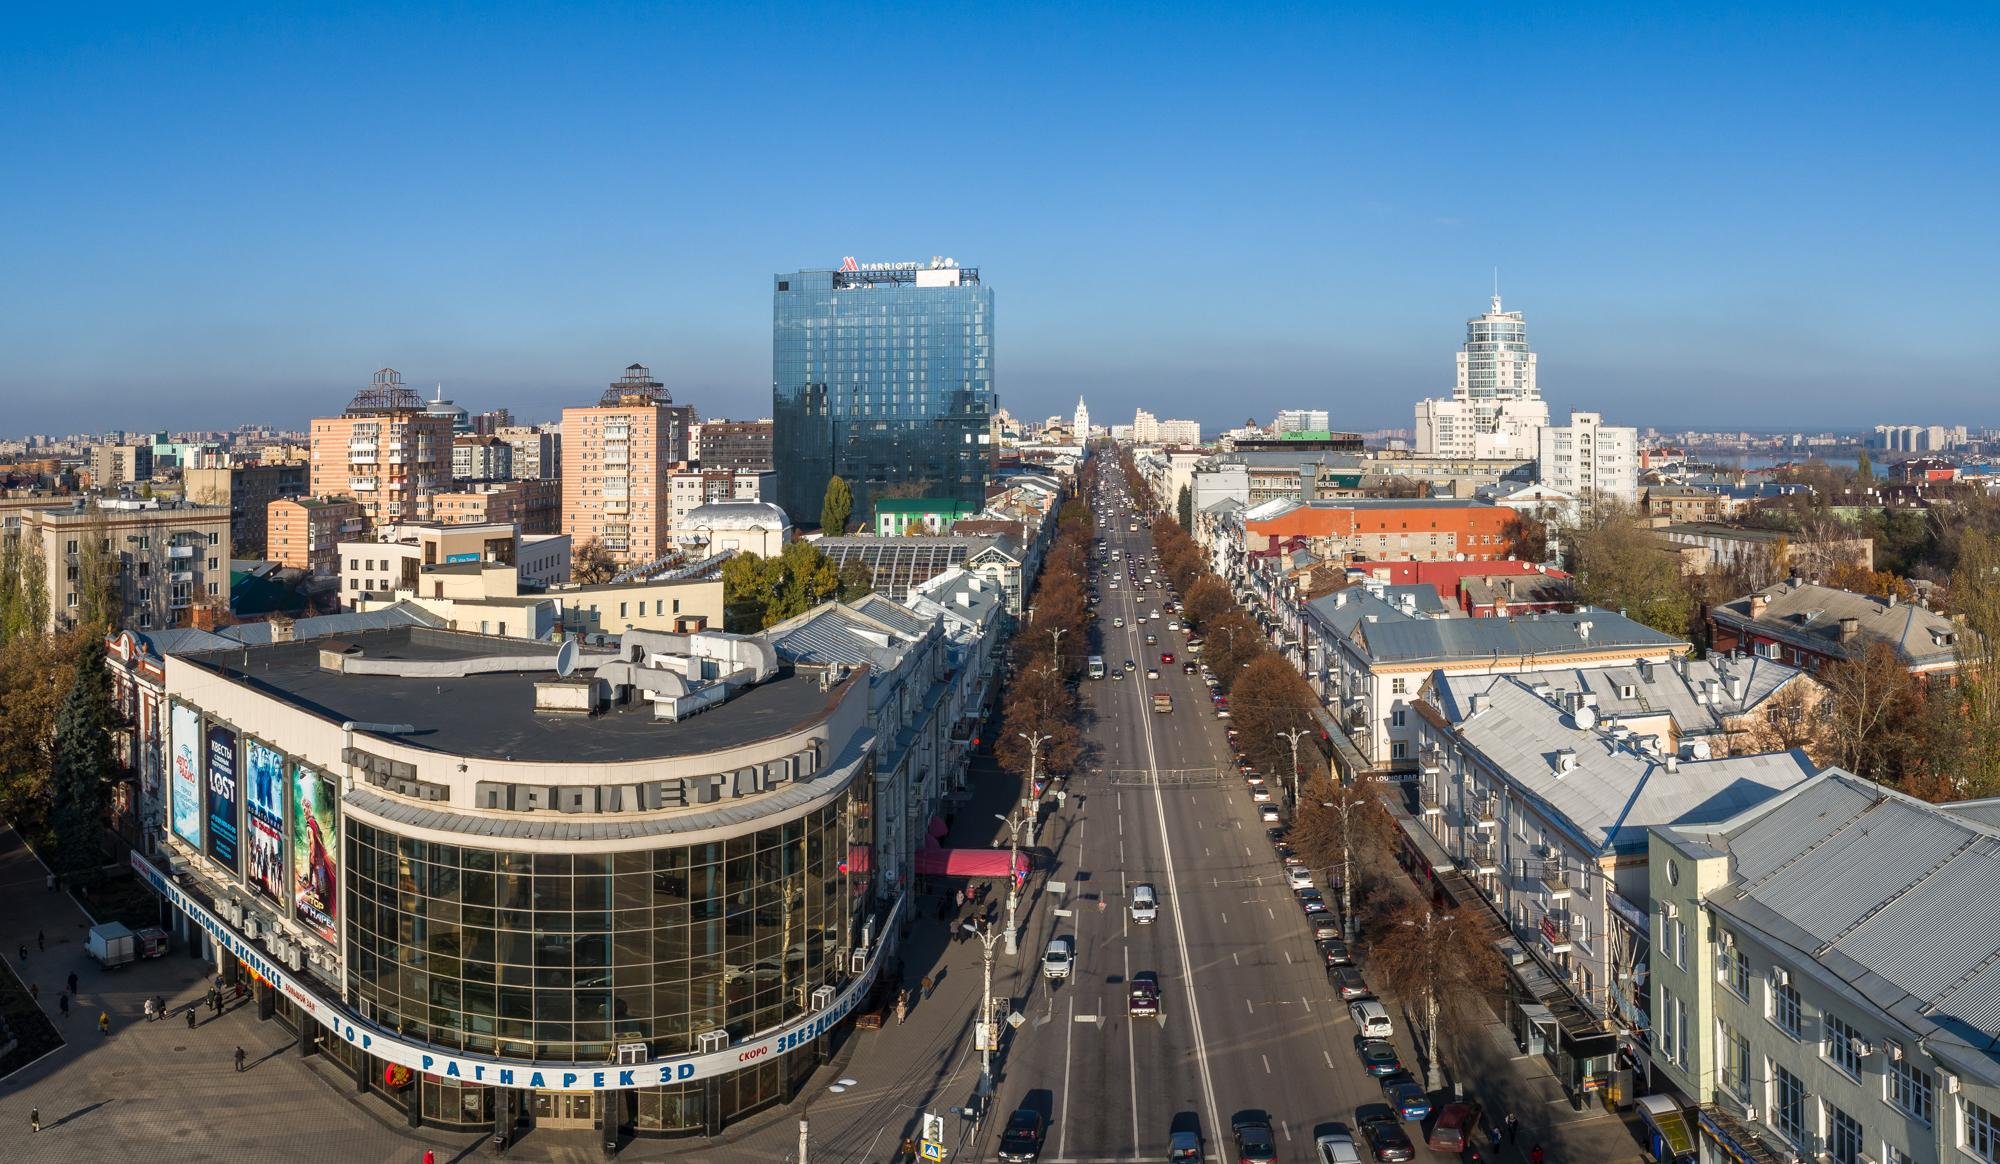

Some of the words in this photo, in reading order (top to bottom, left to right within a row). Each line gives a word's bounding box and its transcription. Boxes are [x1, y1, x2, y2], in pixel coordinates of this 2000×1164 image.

[861, 262, 916, 271] MARRIOTT
[211, 740, 232, 760] КВЕСТЫ
[209, 768, 235, 803] LOST
[308, 896, 325, 910] ТОР
[189, 904, 232, 949] ВОСТОЧНОМ
[234, 940, 282, 989] ЭКСПРЕССЕ
[285, 983, 306, 1005] БОЛЬШОЙ
[738, 1045, 768, 1062] СКОРО
[776, 1001, 849, 1054] ЗВЕЗДНЫЕ
[333, 1016, 372, 1050] ТОР
[422, 1054, 635, 1088] РАГНАРЕК
[659, 1063, 695, 1083] 3D
